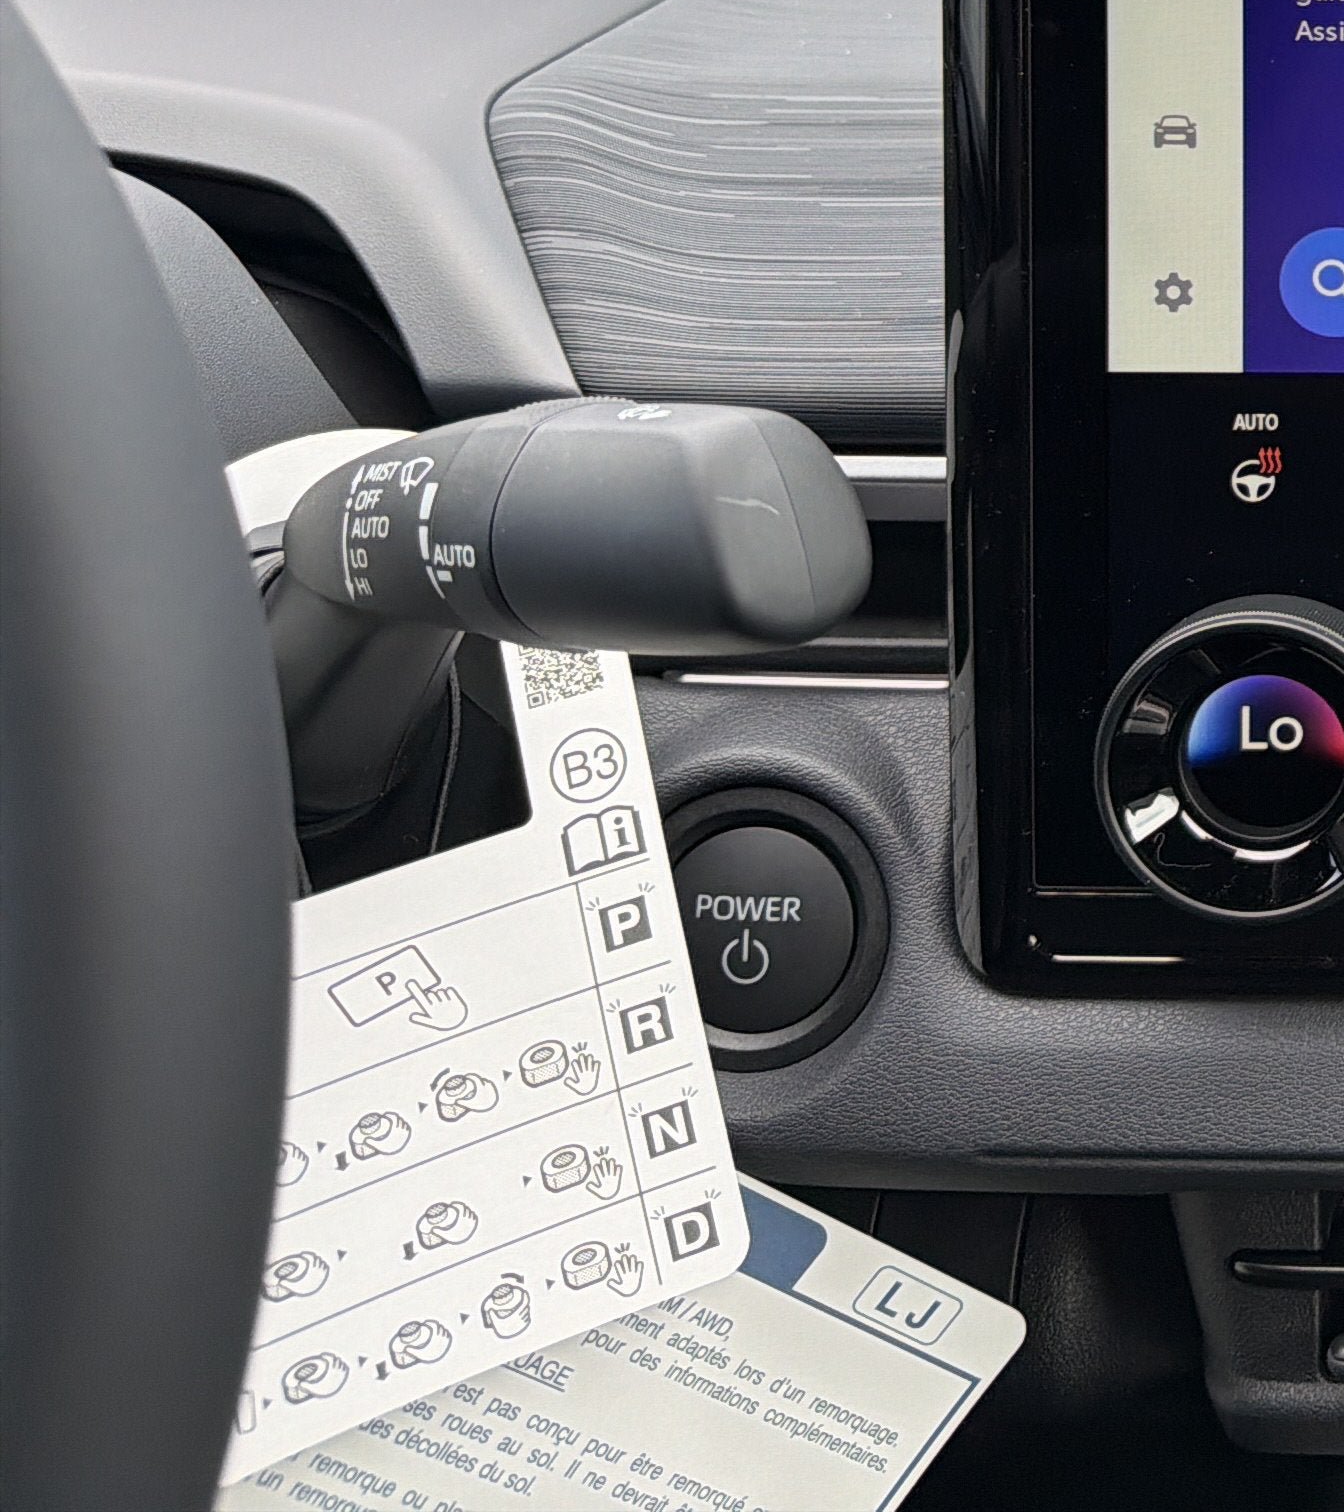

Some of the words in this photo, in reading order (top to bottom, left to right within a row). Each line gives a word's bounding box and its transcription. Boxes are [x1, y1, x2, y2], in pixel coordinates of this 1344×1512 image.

[1232, 412, 1279, 433] AUTO
[362, 461, 402, 483] MIST
[354, 488, 384, 511] OFF
[351, 515, 389, 539] AUTO
[350, 548, 368, 569] LO
[433, 543, 475, 568] AUTO
[353, 576, 373, 596] HI
[1240, 706, 1304, 753] Lo
[563, 743, 619, 790] B3
[613, 903, 642, 947] P
[695, 894, 801, 923] POWER
[375, 970, 398, 996] P
[628, 1002, 665, 1049] R
[651, 1106, 690, 1155] N
[677, 1213, 712, 1253] D
[688, 1307, 734, 1342] AWD,
[875, 1280, 942, 1330] LJ
[505, 1351, 575, 1387] UAGE
[614, 1312, 666, 1340] ment
[666, 1330, 731, 1369] adaptés
[734, 1358, 766, 1386] lors
[769, 1372, 805, 1403] d'un
[809, 1394, 900, 1448] remorquage.
[580, 1328, 627, 1356] pour
[629, 1346, 662, 1372] des
[664, 1359, 760, 1415] informations
[763, 1406, 888, 1474] complémentaires.
[393, 1426, 479, 1473] décollées
[479, 1459, 505, 1484] du
[504, 1469, 540, 1496] sol.
[441, 1413, 494, 1445] roues
[497, 1436, 523, 1457] au
[526, 1449, 555, 1472] sol.
[563, 1459, 582, 1479] Il
[582, 1469, 607, 1491] ne
[611, 1480, 670, 1512] devrait
[482, 1395, 522, 1422] pas
[526, 1413, 581, 1446] conçu
[581, 1437, 627, 1465] pour
[629, 1452, 664, 1481] être
[667, 1472, 749, 1512] remorqué
[308, 1451, 397, 1498] remorque
[401, 1489, 429, 1510] ou
